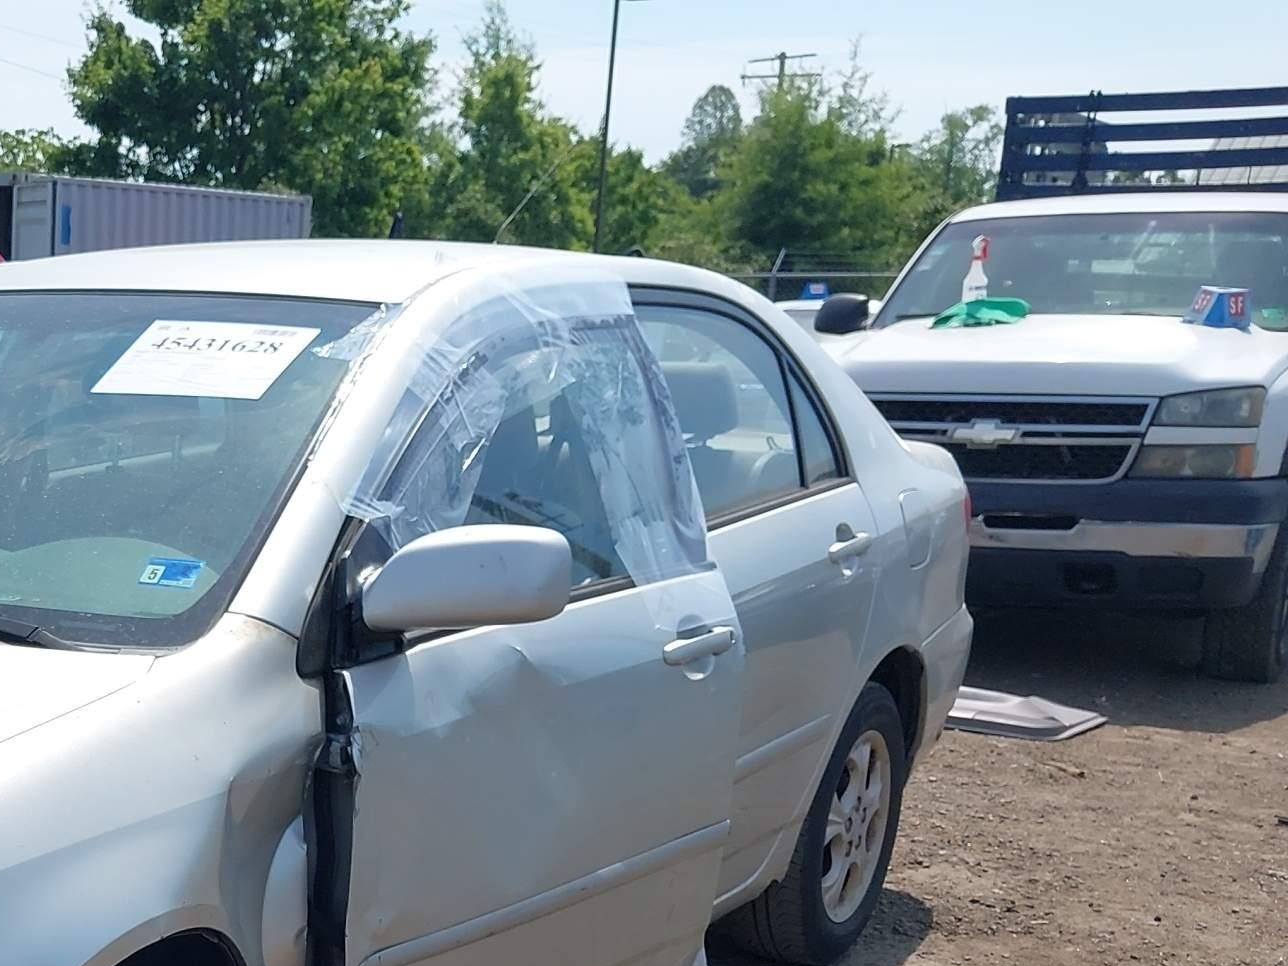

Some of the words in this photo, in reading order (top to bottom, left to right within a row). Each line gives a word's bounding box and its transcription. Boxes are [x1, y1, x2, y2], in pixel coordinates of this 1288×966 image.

[1229, 296, 1244, 315] SF
[151, 336, 284, 354] 45431628
[148, 568, 160, 580] 5
